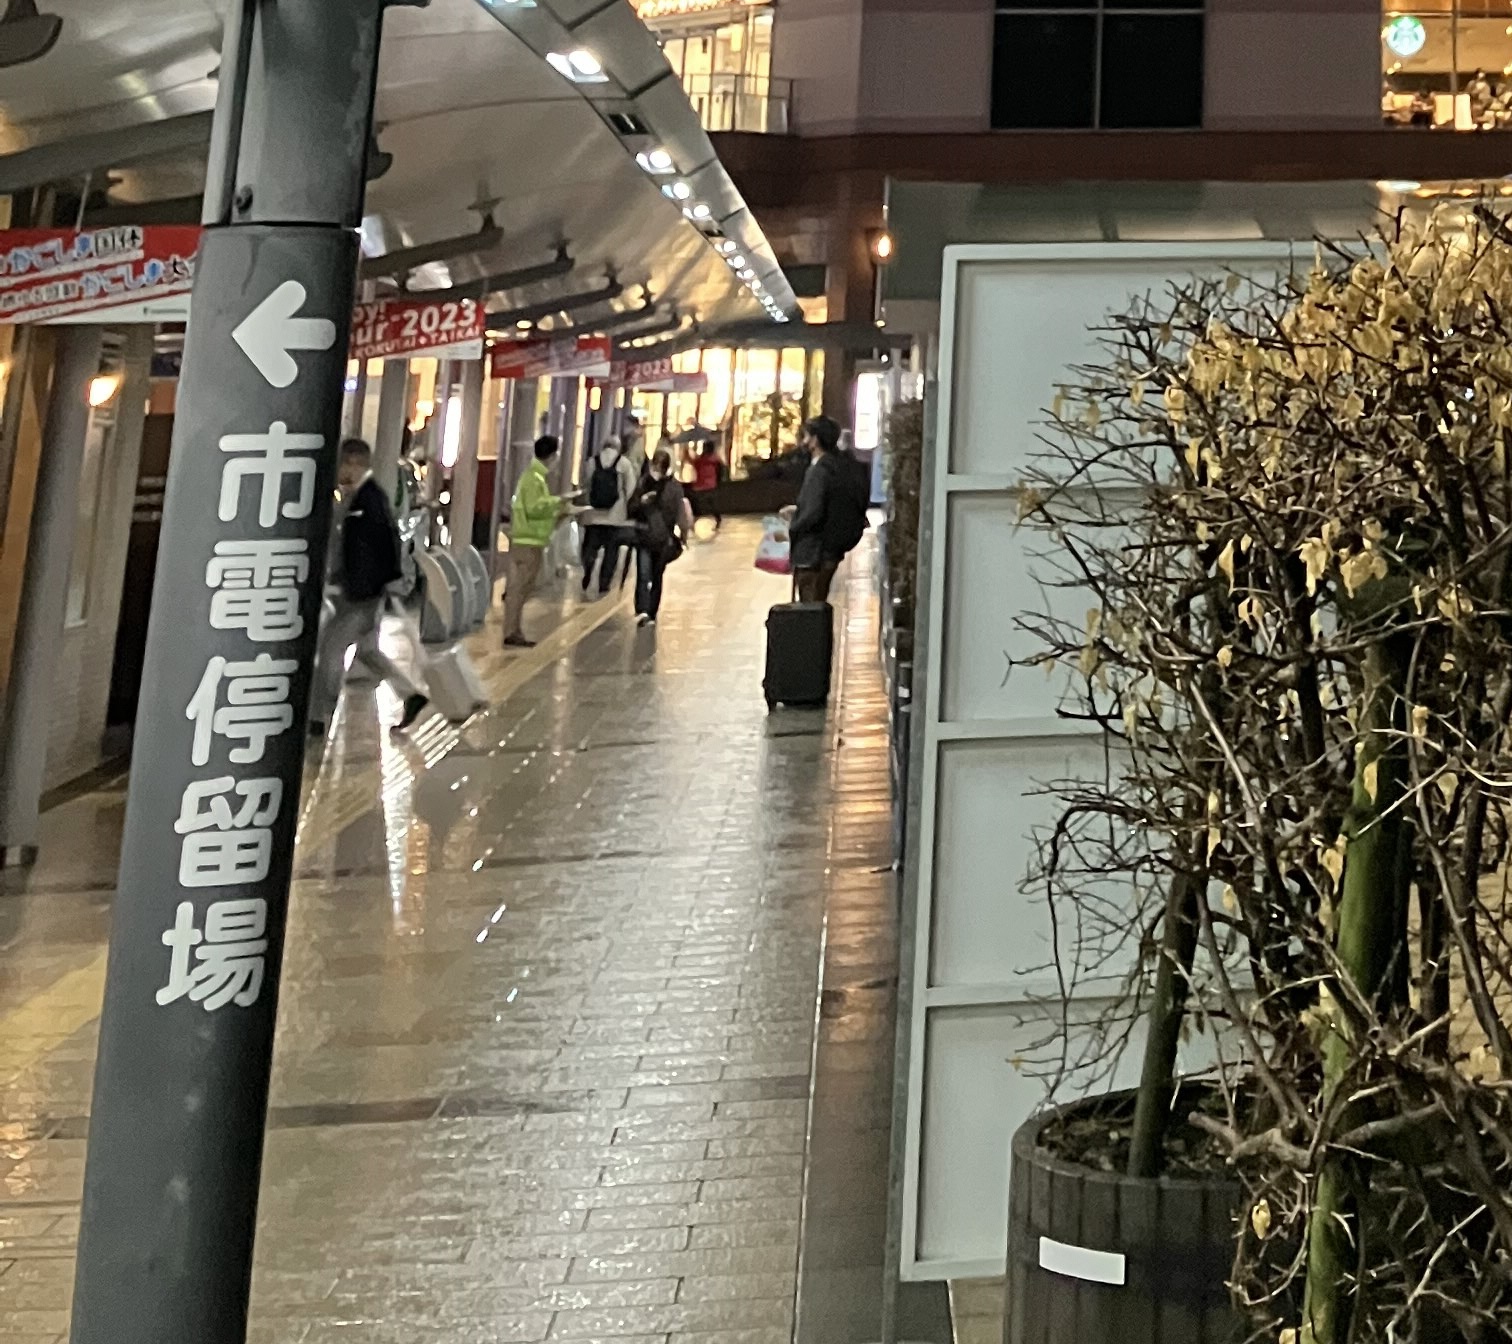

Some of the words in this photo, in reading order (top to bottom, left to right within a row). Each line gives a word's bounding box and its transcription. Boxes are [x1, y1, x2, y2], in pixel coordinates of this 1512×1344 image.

[155, 420, 326, 1013] 市電停留場
